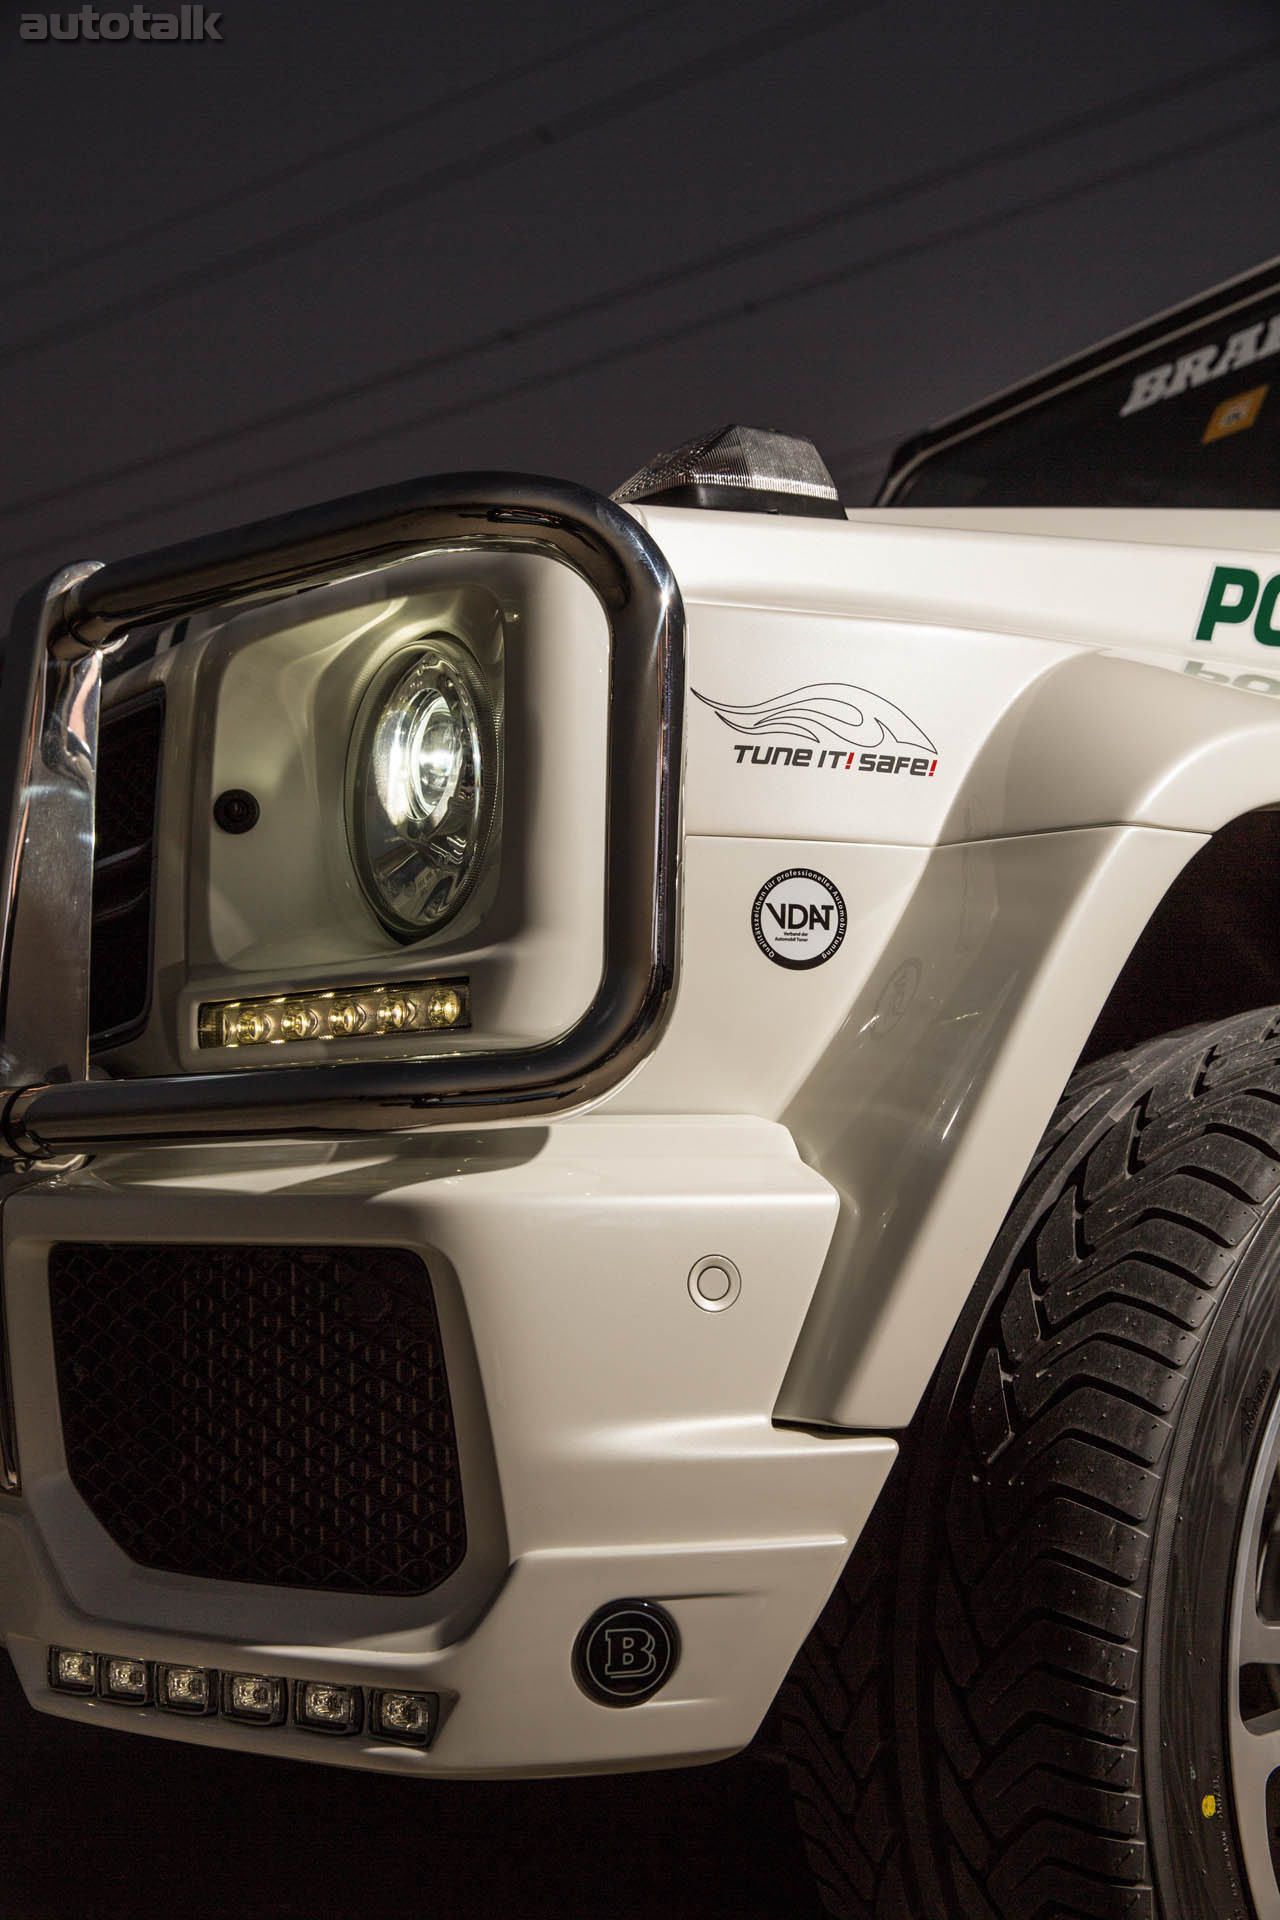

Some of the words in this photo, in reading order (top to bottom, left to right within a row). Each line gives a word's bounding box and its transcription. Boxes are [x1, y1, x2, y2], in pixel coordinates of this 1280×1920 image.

[817, 750, 855, 770] IT!
[764, 880, 776, 891] für
[776, 869, 834, 892] professionelles
[765, 902, 835, 931] VDAT
[831, 890, 846, 936] Automobil
[821, 935, 843, 959] Tuning
[604, 1627, 657, 1679] B
